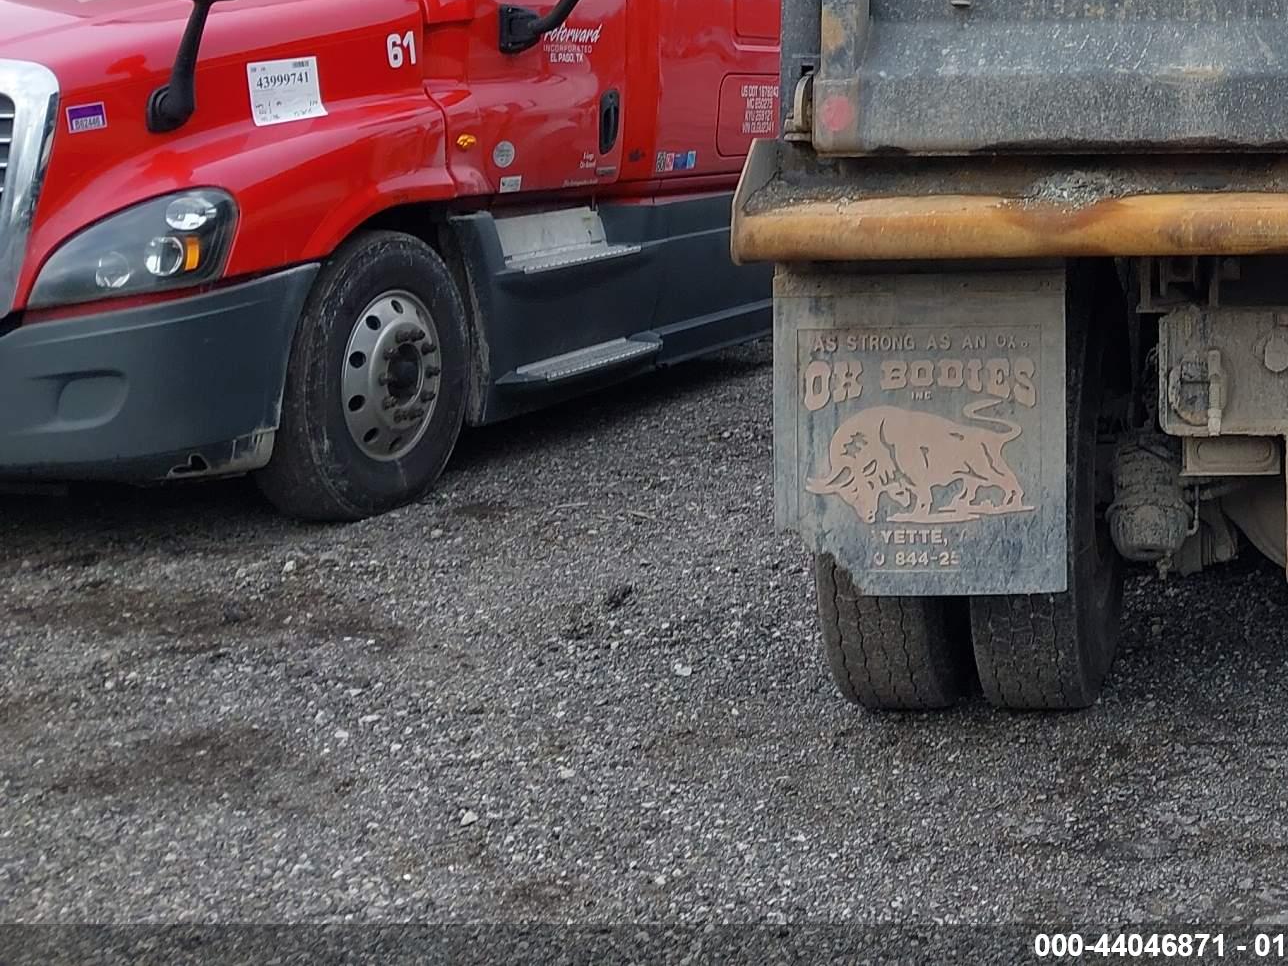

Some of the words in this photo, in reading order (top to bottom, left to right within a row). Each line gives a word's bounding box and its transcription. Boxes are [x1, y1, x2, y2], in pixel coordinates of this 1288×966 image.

[386, 30, 417, 68] 61
[543, 44, 593, 54] INCORPORATED
[550, 53, 558, 62] EL
[576, 53, 584, 62] TX
[256, 70, 309, 90] 43999741
[813, 335, 838, 351] AS
[847, 334, 915, 352] STRONG
[926, 335, 951, 350] AS
[962, 334, 986, 348] AN
[995, 335, 1016, 348] OX
[803, 360, 863, 411] OX
[880, 357, 1037, 409] BODIES
[910, 391, 932, 401] INC
[872, 529, 948, 546] YETTE,
